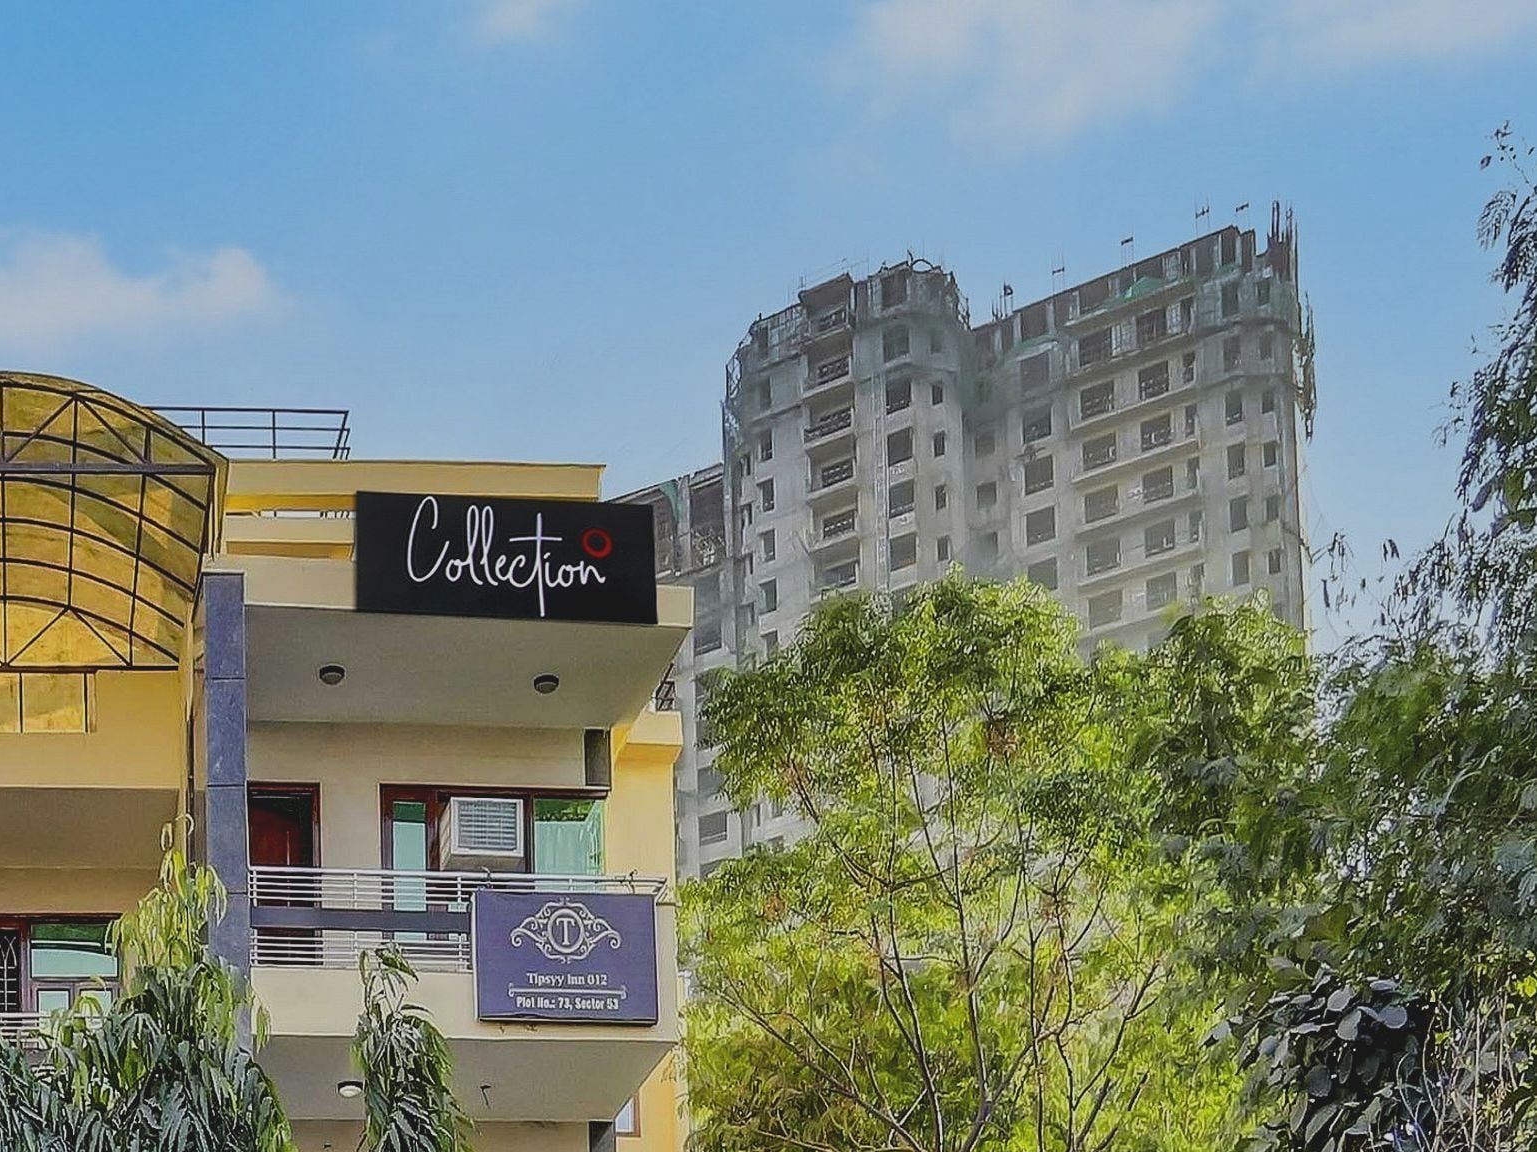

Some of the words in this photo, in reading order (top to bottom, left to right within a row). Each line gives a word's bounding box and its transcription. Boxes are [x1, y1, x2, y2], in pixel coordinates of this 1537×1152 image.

[406, 495, 607, 618] Collection
[526, 972, 565, 987] Tipsyy
[567, 973, 585, 985] Inn
[587, 974, 608, 986] 012
[516, 996, 535, 1008] Plot
[558, 997, 573, 1010] 73,
[574, 997, 605, 1010] Sector
[606, 998, 619, 1010] 53
